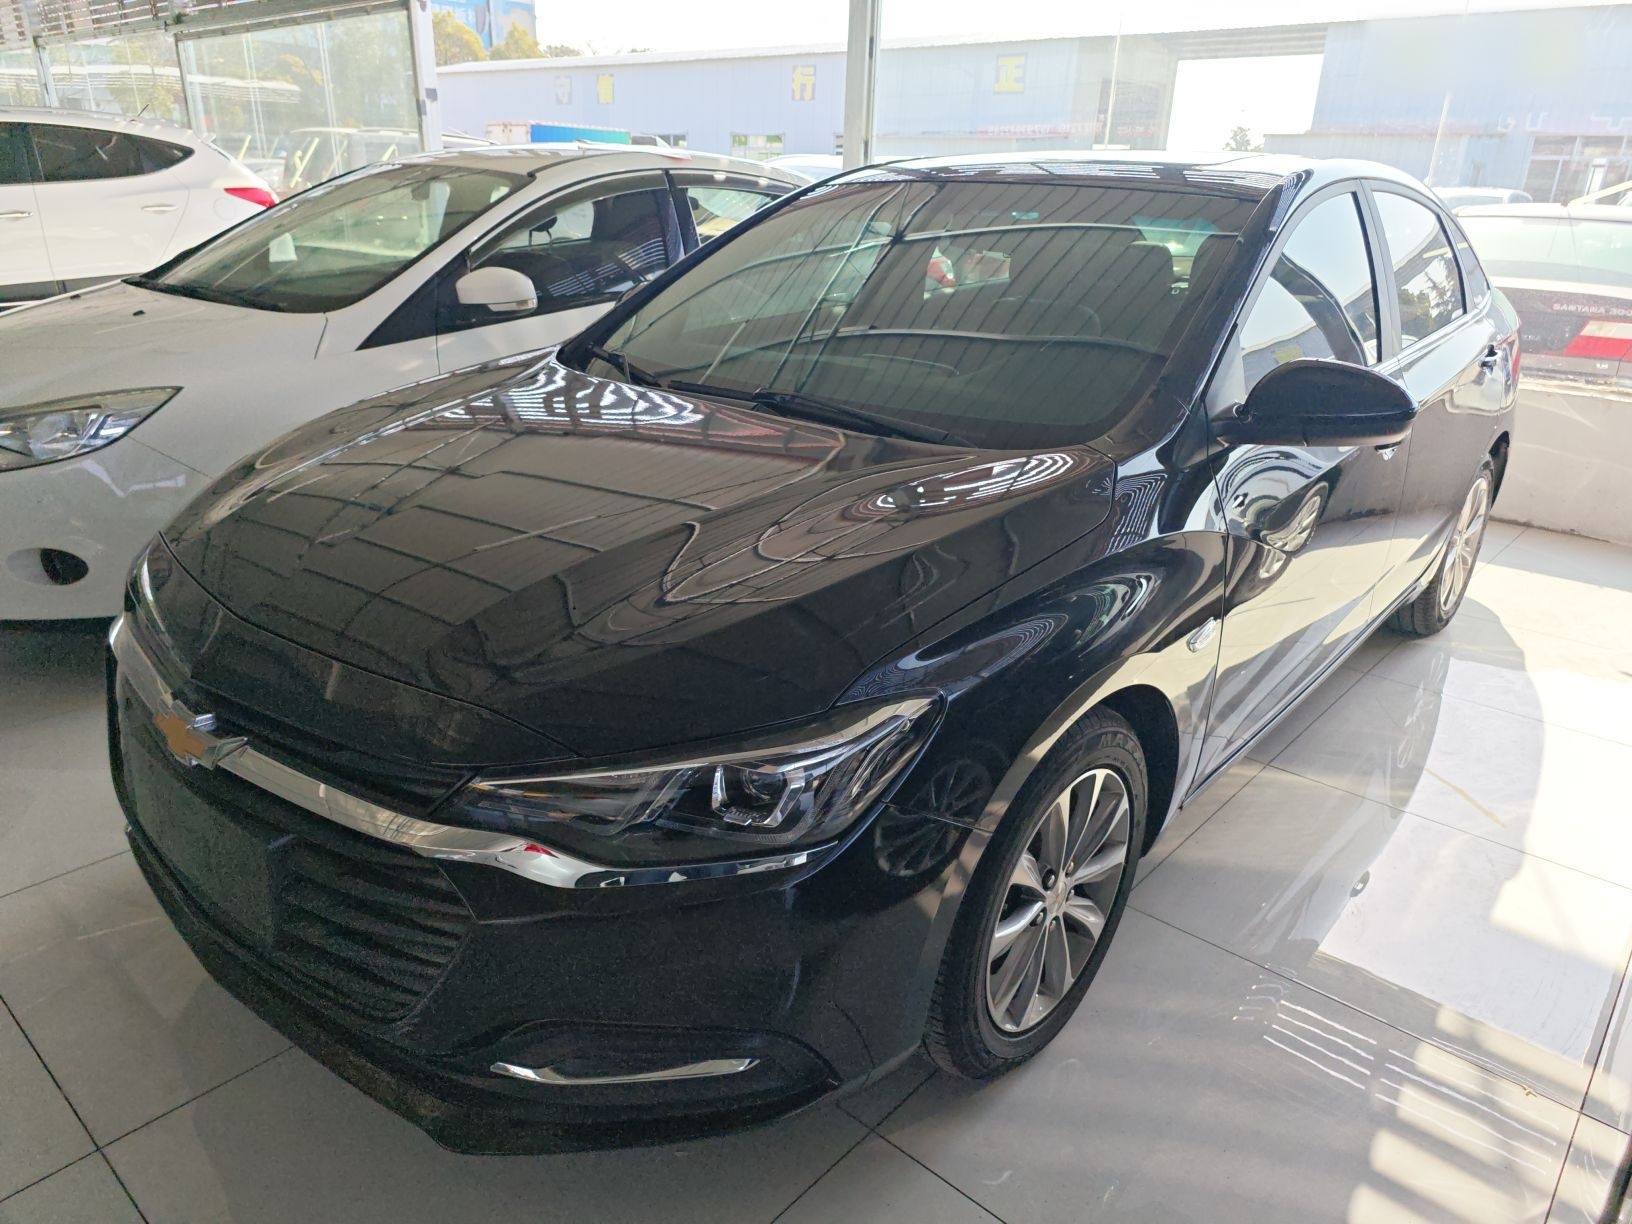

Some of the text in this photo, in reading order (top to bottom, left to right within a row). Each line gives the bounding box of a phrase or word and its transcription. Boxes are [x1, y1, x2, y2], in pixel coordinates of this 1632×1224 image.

[792, 65, 816, 102] 行
[992, 56, 1026, 93] 正
[1553, 303, 1605, 314] SANTANA
